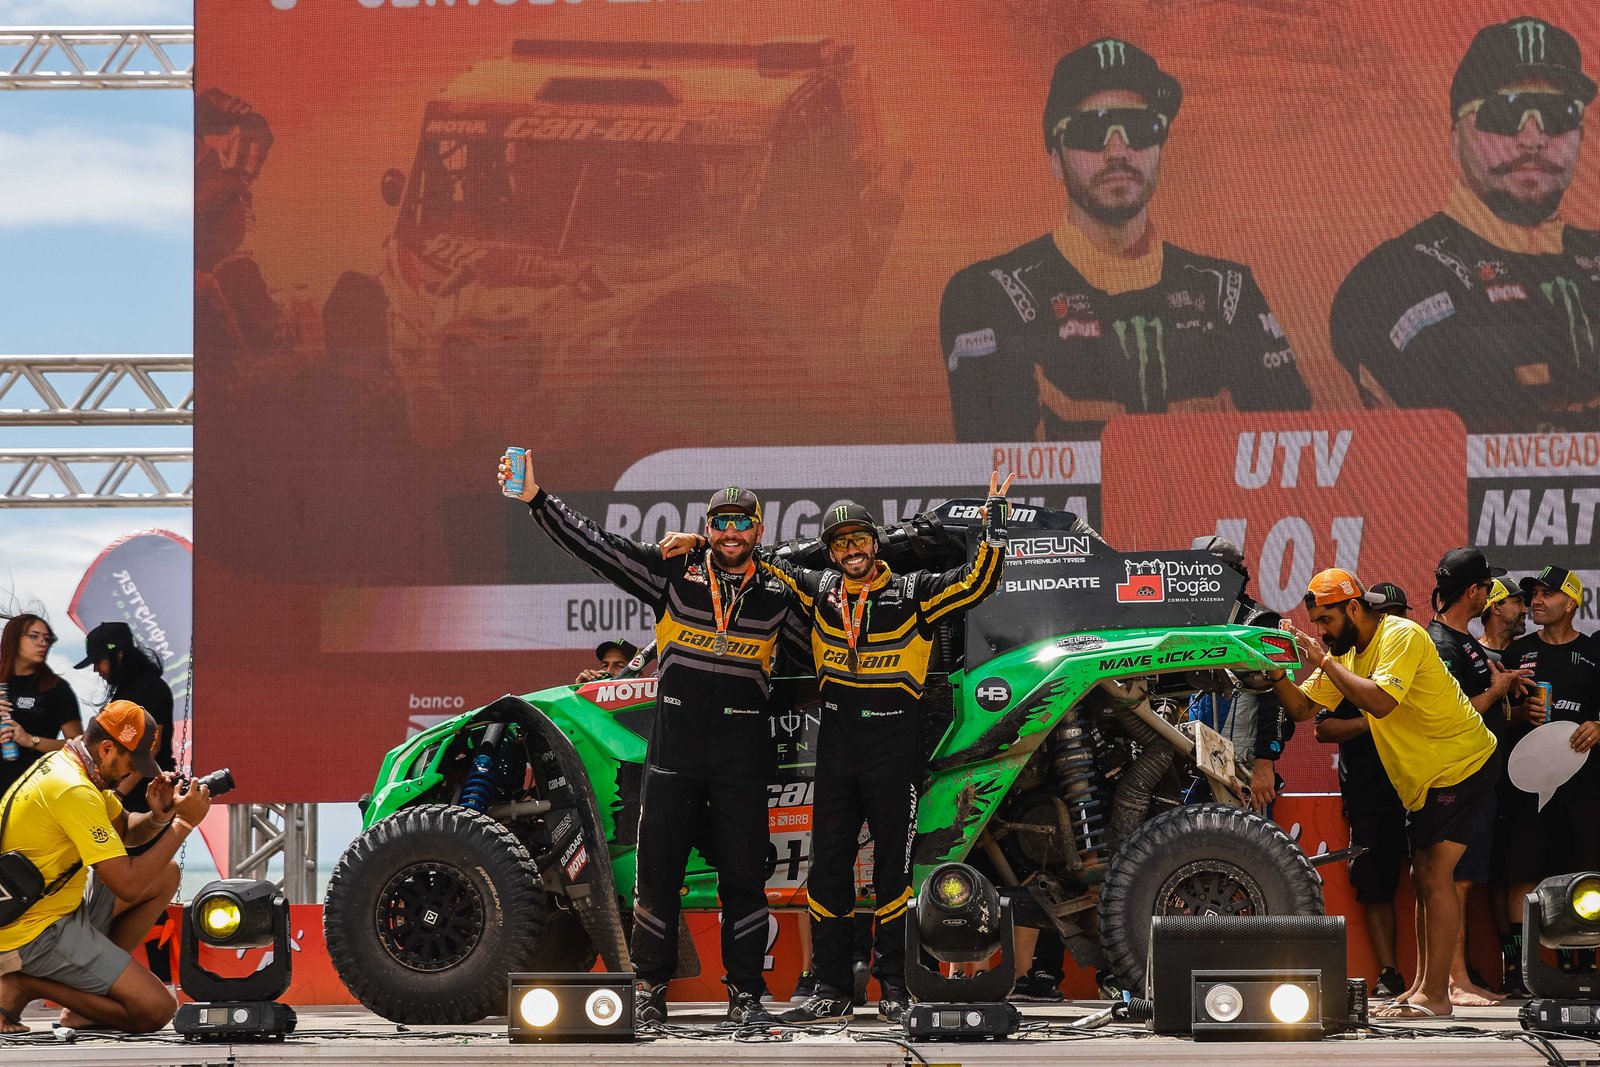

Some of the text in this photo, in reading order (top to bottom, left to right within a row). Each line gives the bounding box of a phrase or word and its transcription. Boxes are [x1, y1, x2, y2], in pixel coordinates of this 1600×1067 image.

[993, 447, 1076, 480] PILOTO
[1234, 430, 1353, 489] UTV
[1166, 560, 1223, 577] Divino
[1005, 576, 1101, 593] BLINDARTE
[1167, 577, 1221, 596] Fogão
[1198, 646, 1228, 661] X3
[409, 693, 464, 708] banco
[788, 814, 809, 826] BRB
